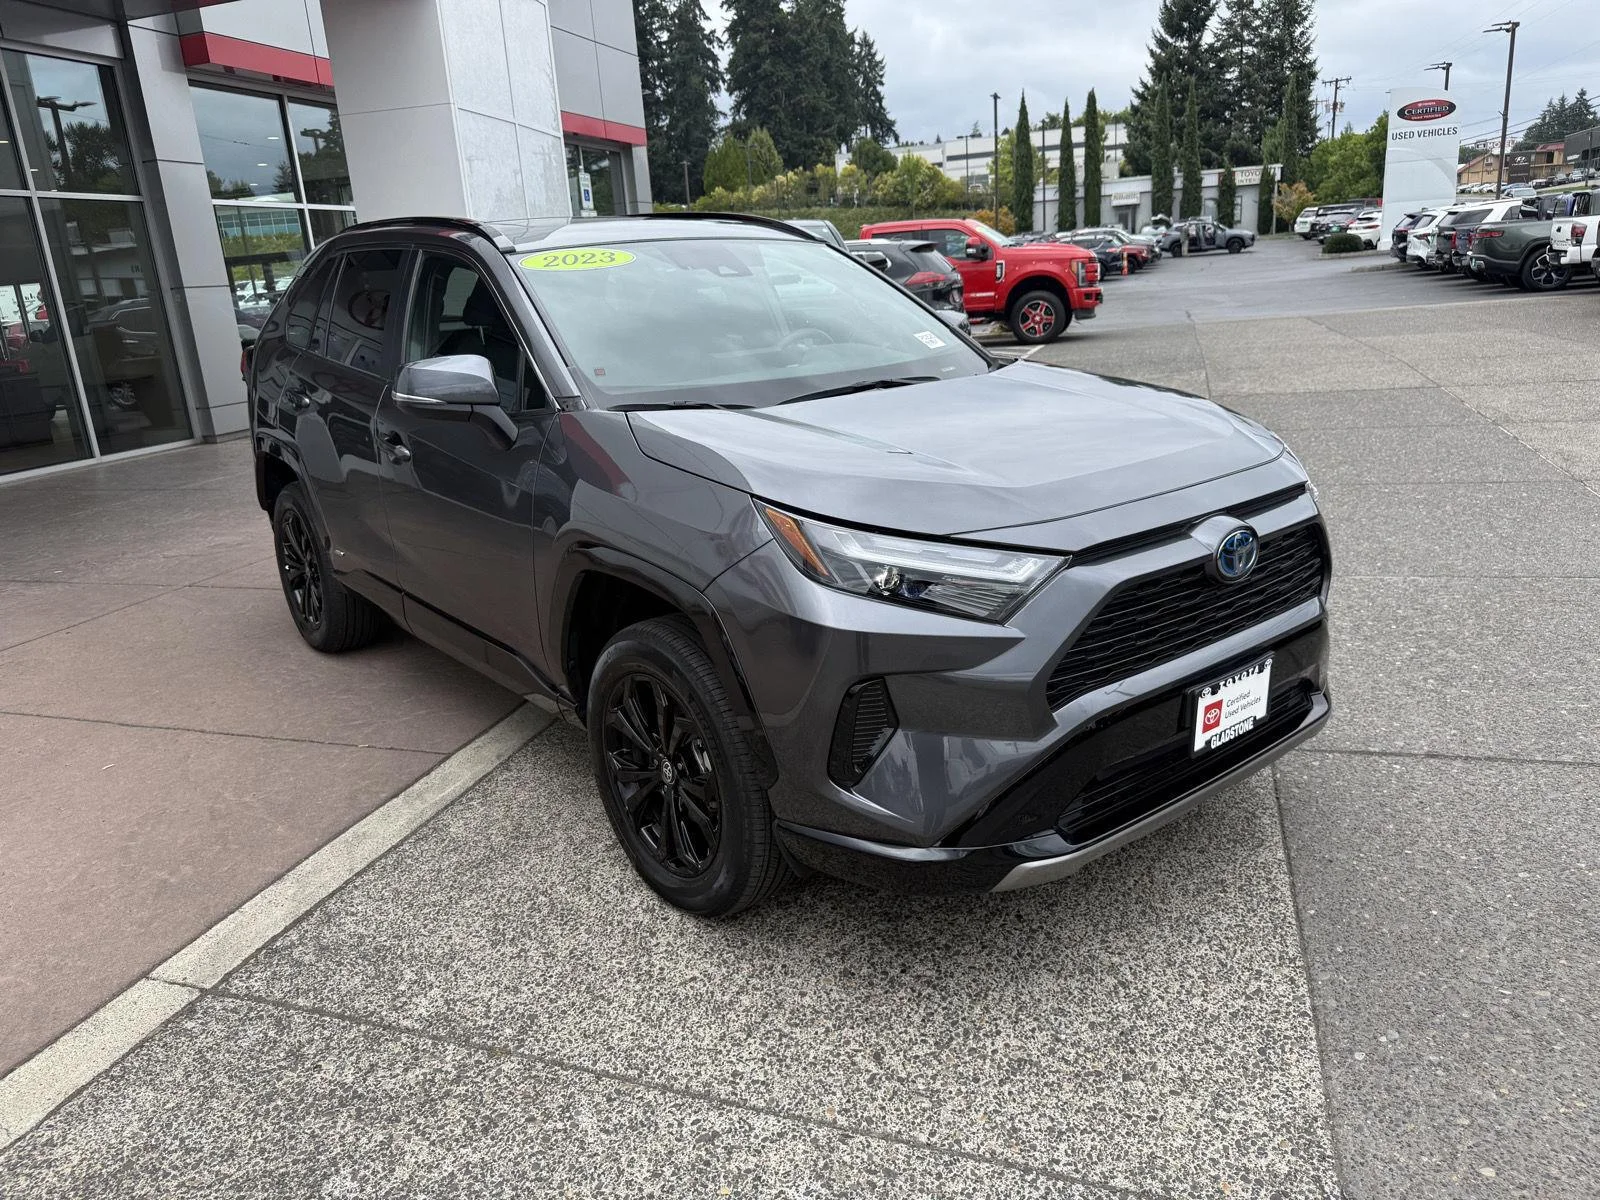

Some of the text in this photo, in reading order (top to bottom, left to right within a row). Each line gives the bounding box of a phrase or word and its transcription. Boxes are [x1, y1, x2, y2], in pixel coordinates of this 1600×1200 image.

[1391, 127, 1458, 141] USED VEHICLES
[1487, 139, 1516, 149] MOEL
[543, 252, 616, 268] 2023
[1219, 665, 1260, 690] TOYOTA
[1224, 695, 1262, 719] Used Vehicles
[1226, 689, 1252, 708] Certified
[1210, 716, 1255, 749] GLADSTONE
